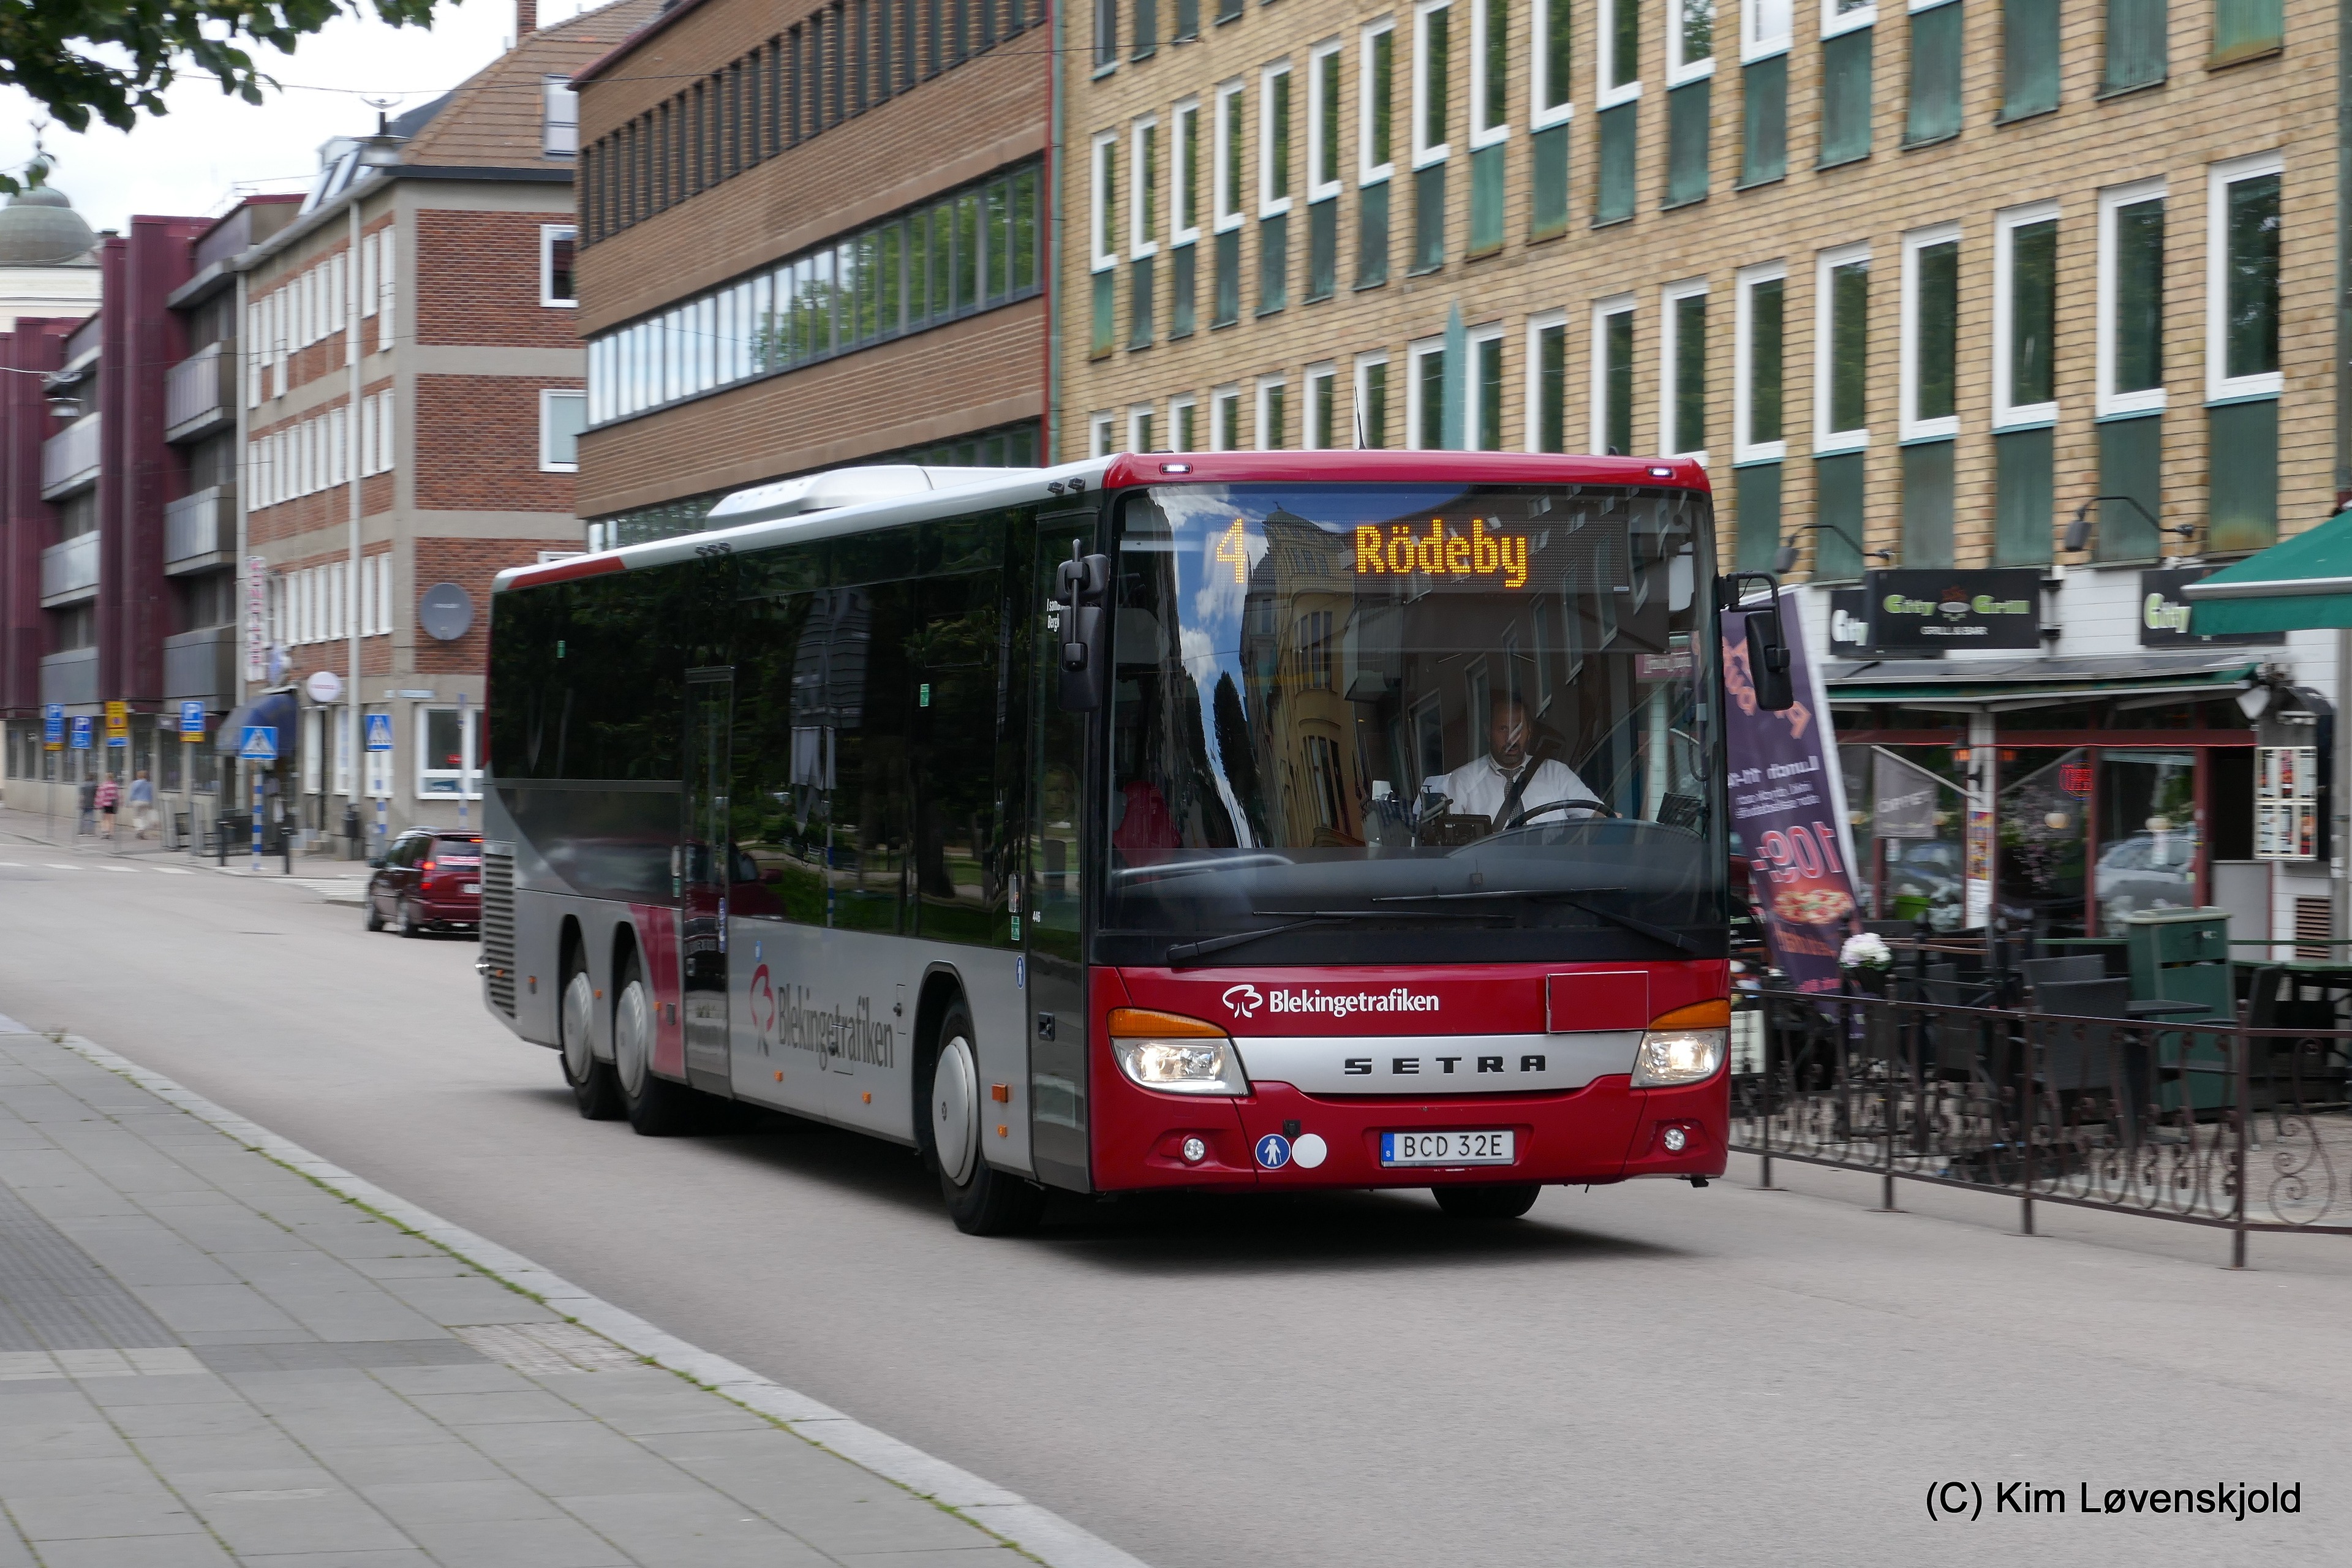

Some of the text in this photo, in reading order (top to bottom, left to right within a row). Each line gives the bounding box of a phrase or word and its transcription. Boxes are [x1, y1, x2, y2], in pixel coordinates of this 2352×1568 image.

[1216, 518, 1527, 587] 4 Rödeby
[1270, 988, 1439, 1017] Blekingetrafiken
[778, 983, 894, 1071] Blekingetrafiken
[1344, 1055, 1546, 1075] SETRA
[1404, 1134, 1502, 1158] BCD 32E
